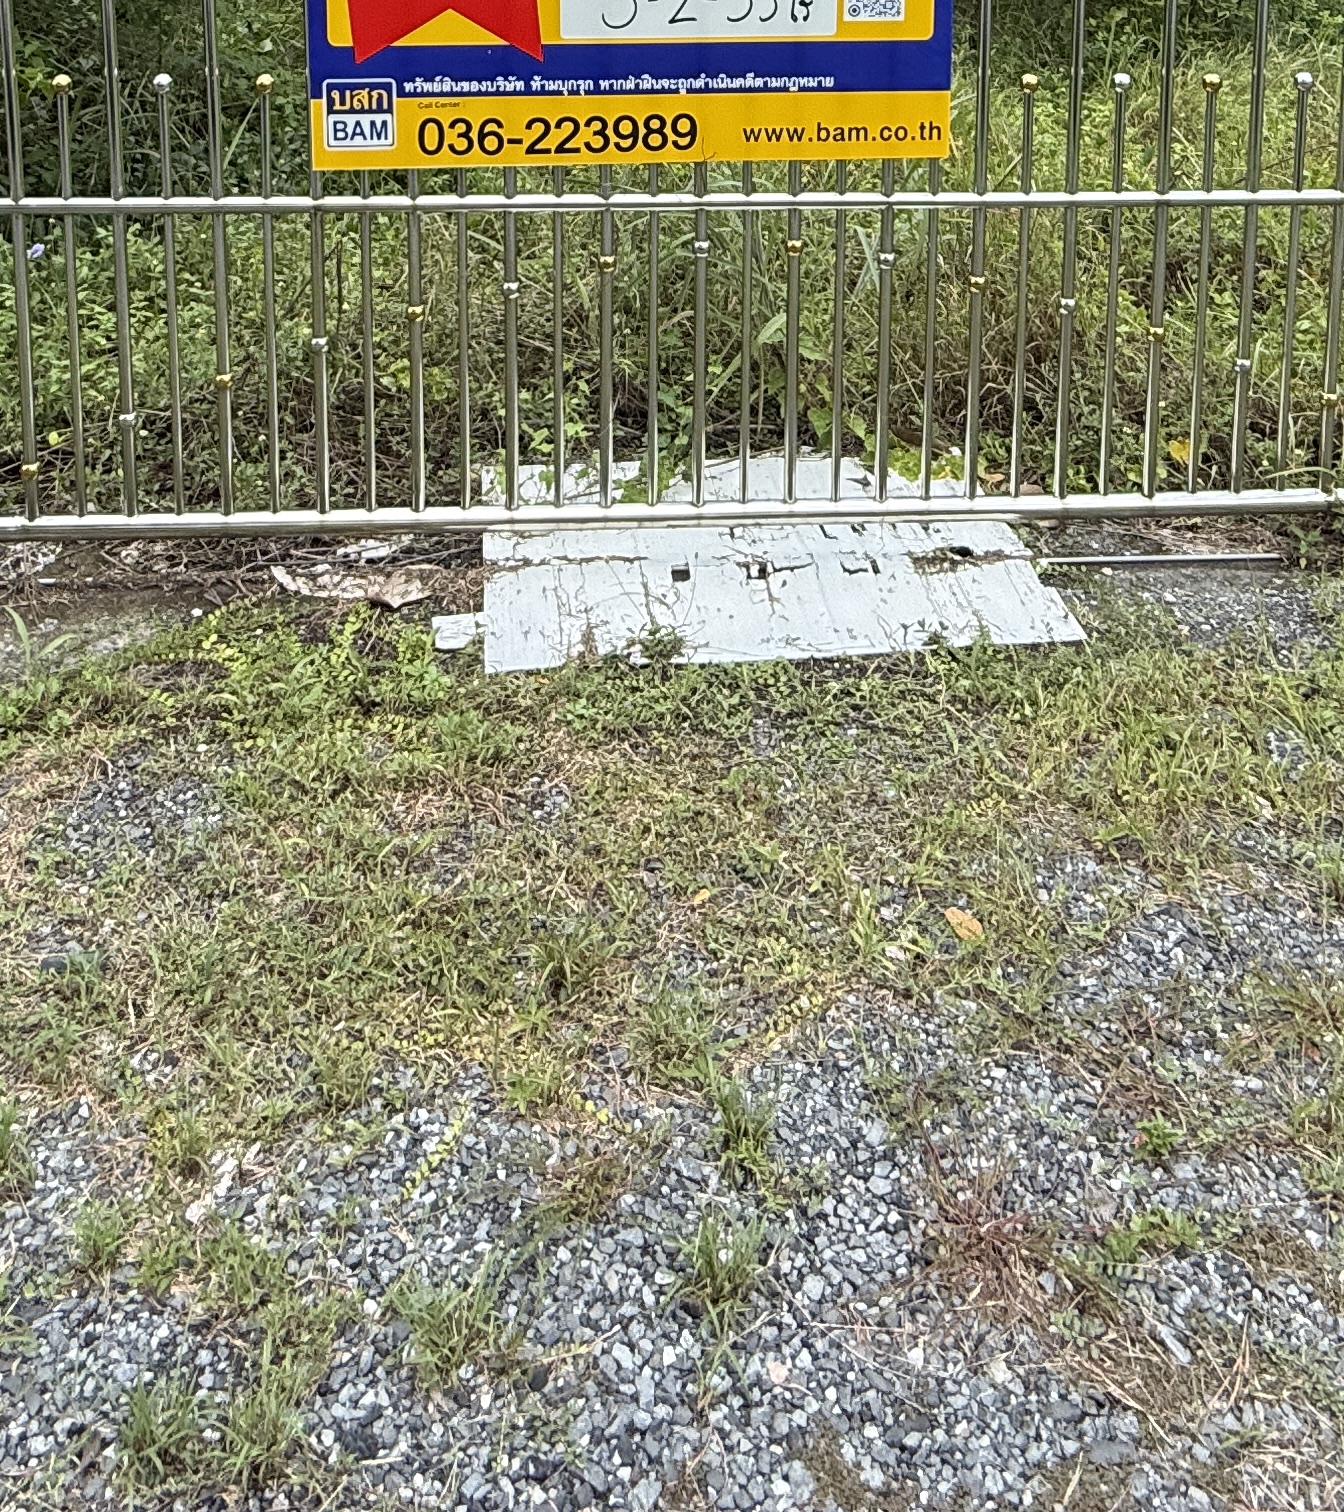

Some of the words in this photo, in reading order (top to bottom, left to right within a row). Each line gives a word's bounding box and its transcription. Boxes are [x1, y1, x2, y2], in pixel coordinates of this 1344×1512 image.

[403, 75, 525, 93] ทรัพย์สินของบริษัท
[530, 75, 595, 96] ห้ามบุกรุก
[330, 86, 389, 111] บสก
[332, 119, 389, 142] BAM
[417, 113, 698, 156] 036-223989
[742, 120, 943, 144] www.bam.co.th
